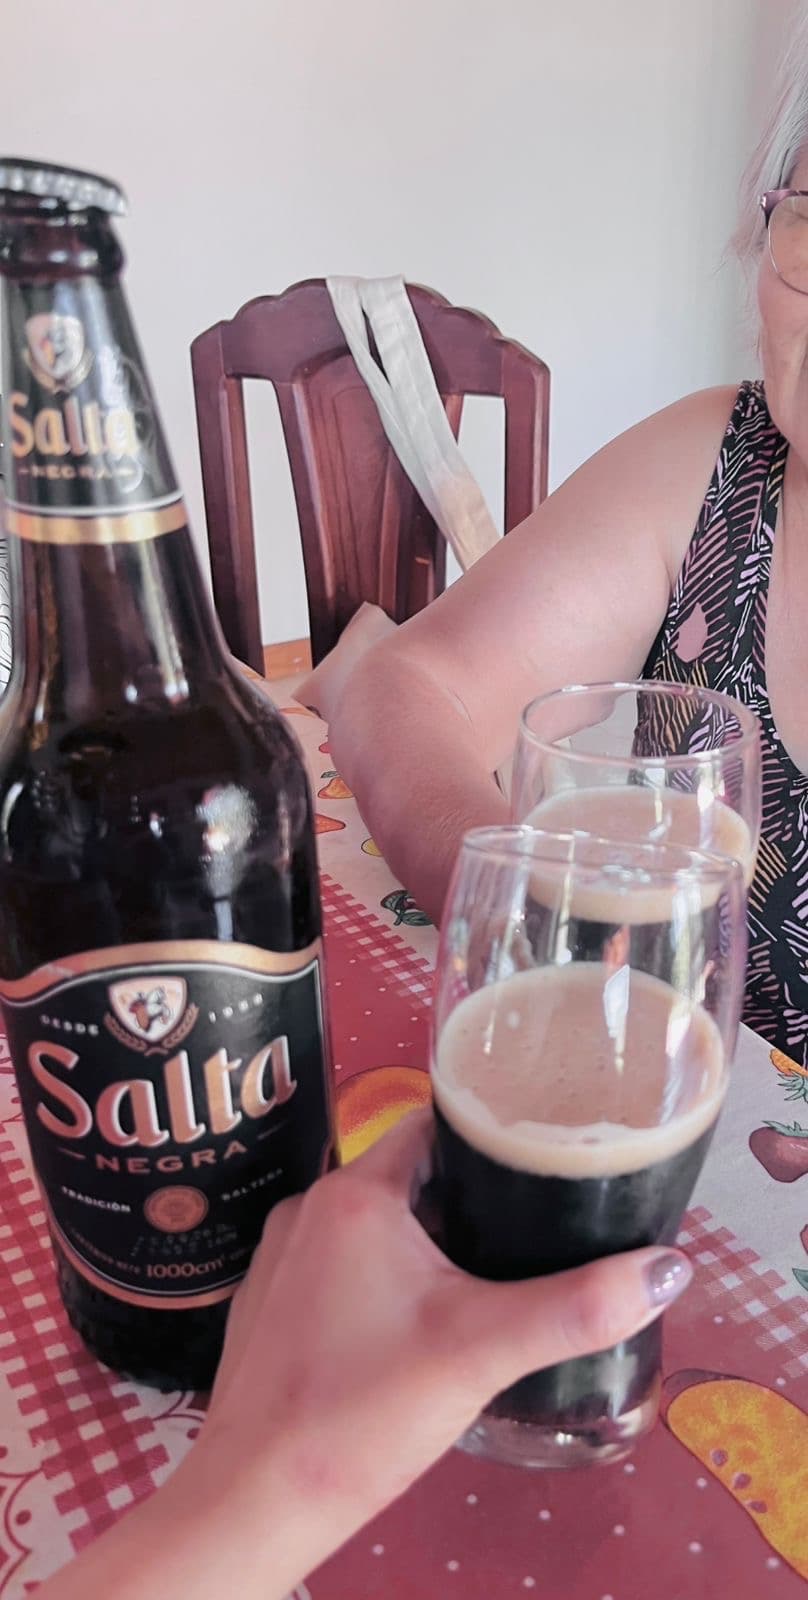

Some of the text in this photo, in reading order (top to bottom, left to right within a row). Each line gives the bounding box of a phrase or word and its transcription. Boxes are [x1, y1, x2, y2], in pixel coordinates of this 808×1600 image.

[9, 391, 139, 456] Salta
[40, 1015, 98, 1036] DESDE
[28, 1035, 297, 1147] Salta
[96, 1140, 248, 1174] NEGRA
[62, 1185, 131, 1213] TRADICIÓN
